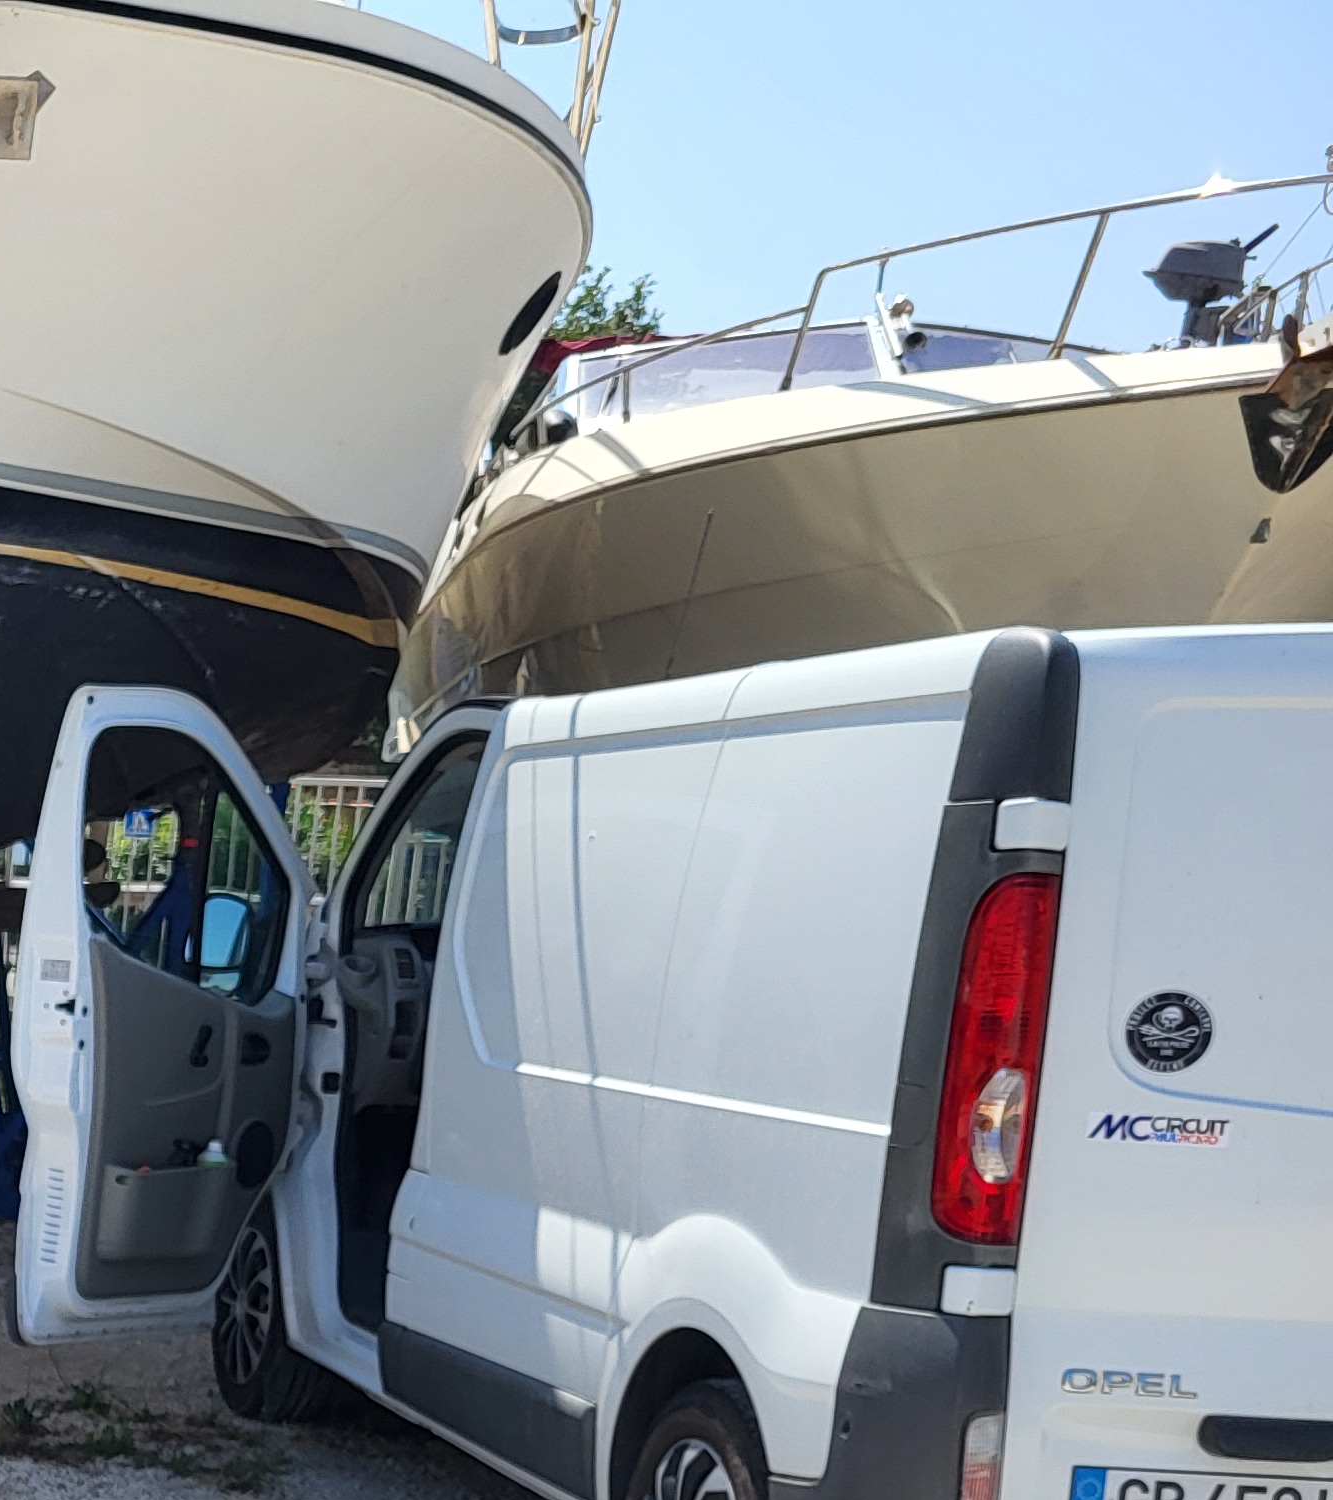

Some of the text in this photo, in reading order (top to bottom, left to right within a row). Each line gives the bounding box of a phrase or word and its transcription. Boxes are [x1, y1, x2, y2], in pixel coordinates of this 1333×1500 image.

[1087, 1114, 1230, 1142] MC CIRCUIT
[1060, 1367, 1199, 1400] OPEL
